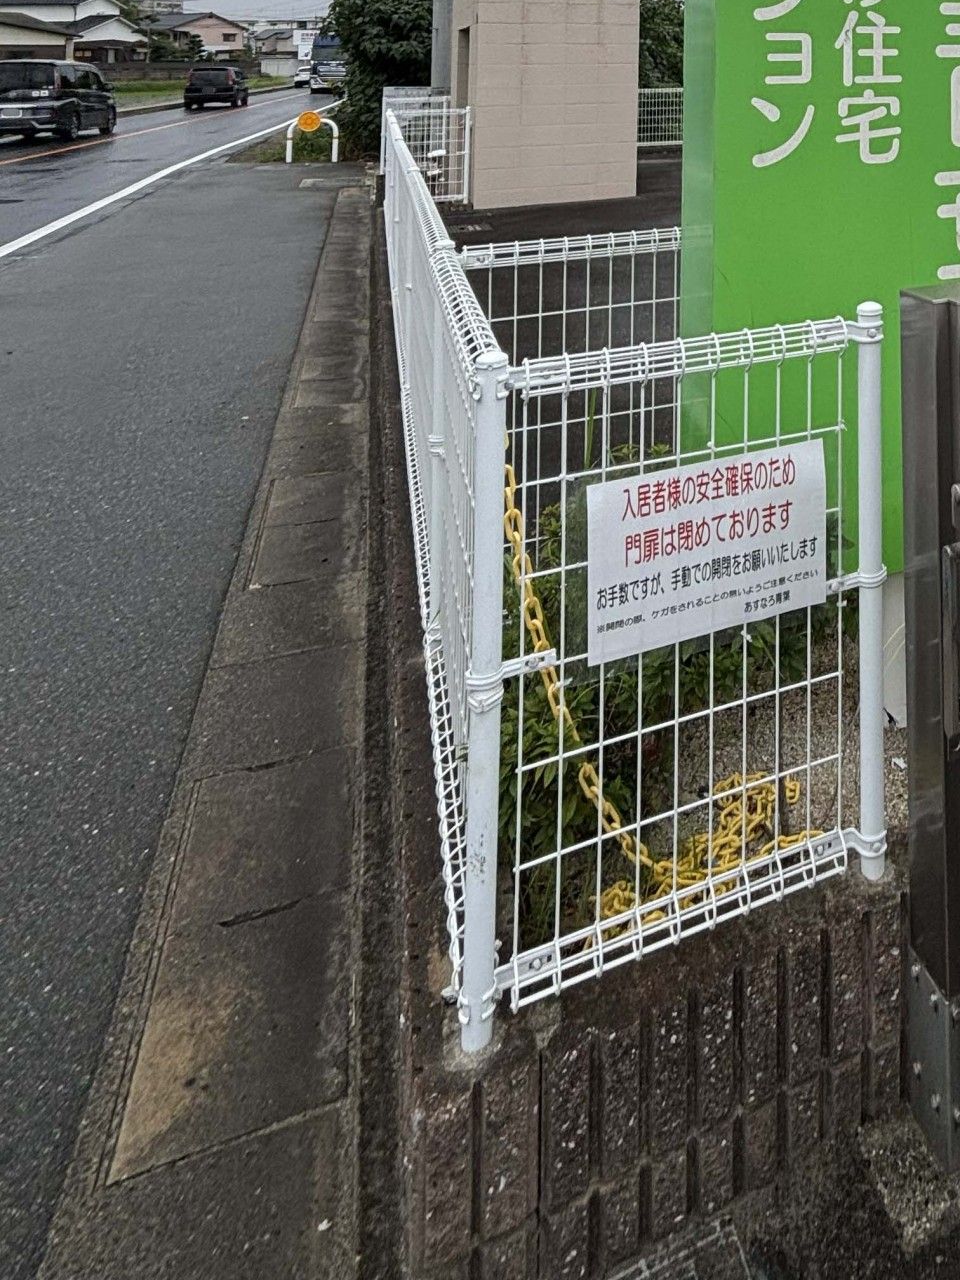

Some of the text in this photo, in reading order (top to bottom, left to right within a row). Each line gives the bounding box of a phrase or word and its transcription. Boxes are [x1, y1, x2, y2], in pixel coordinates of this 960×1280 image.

[621, 452, 796, 522] 入居者様の安全確保のため
[624, 499, 794, 568] 門扉は閉めております
[743, 589, 791, 614] あすなろ青葉
